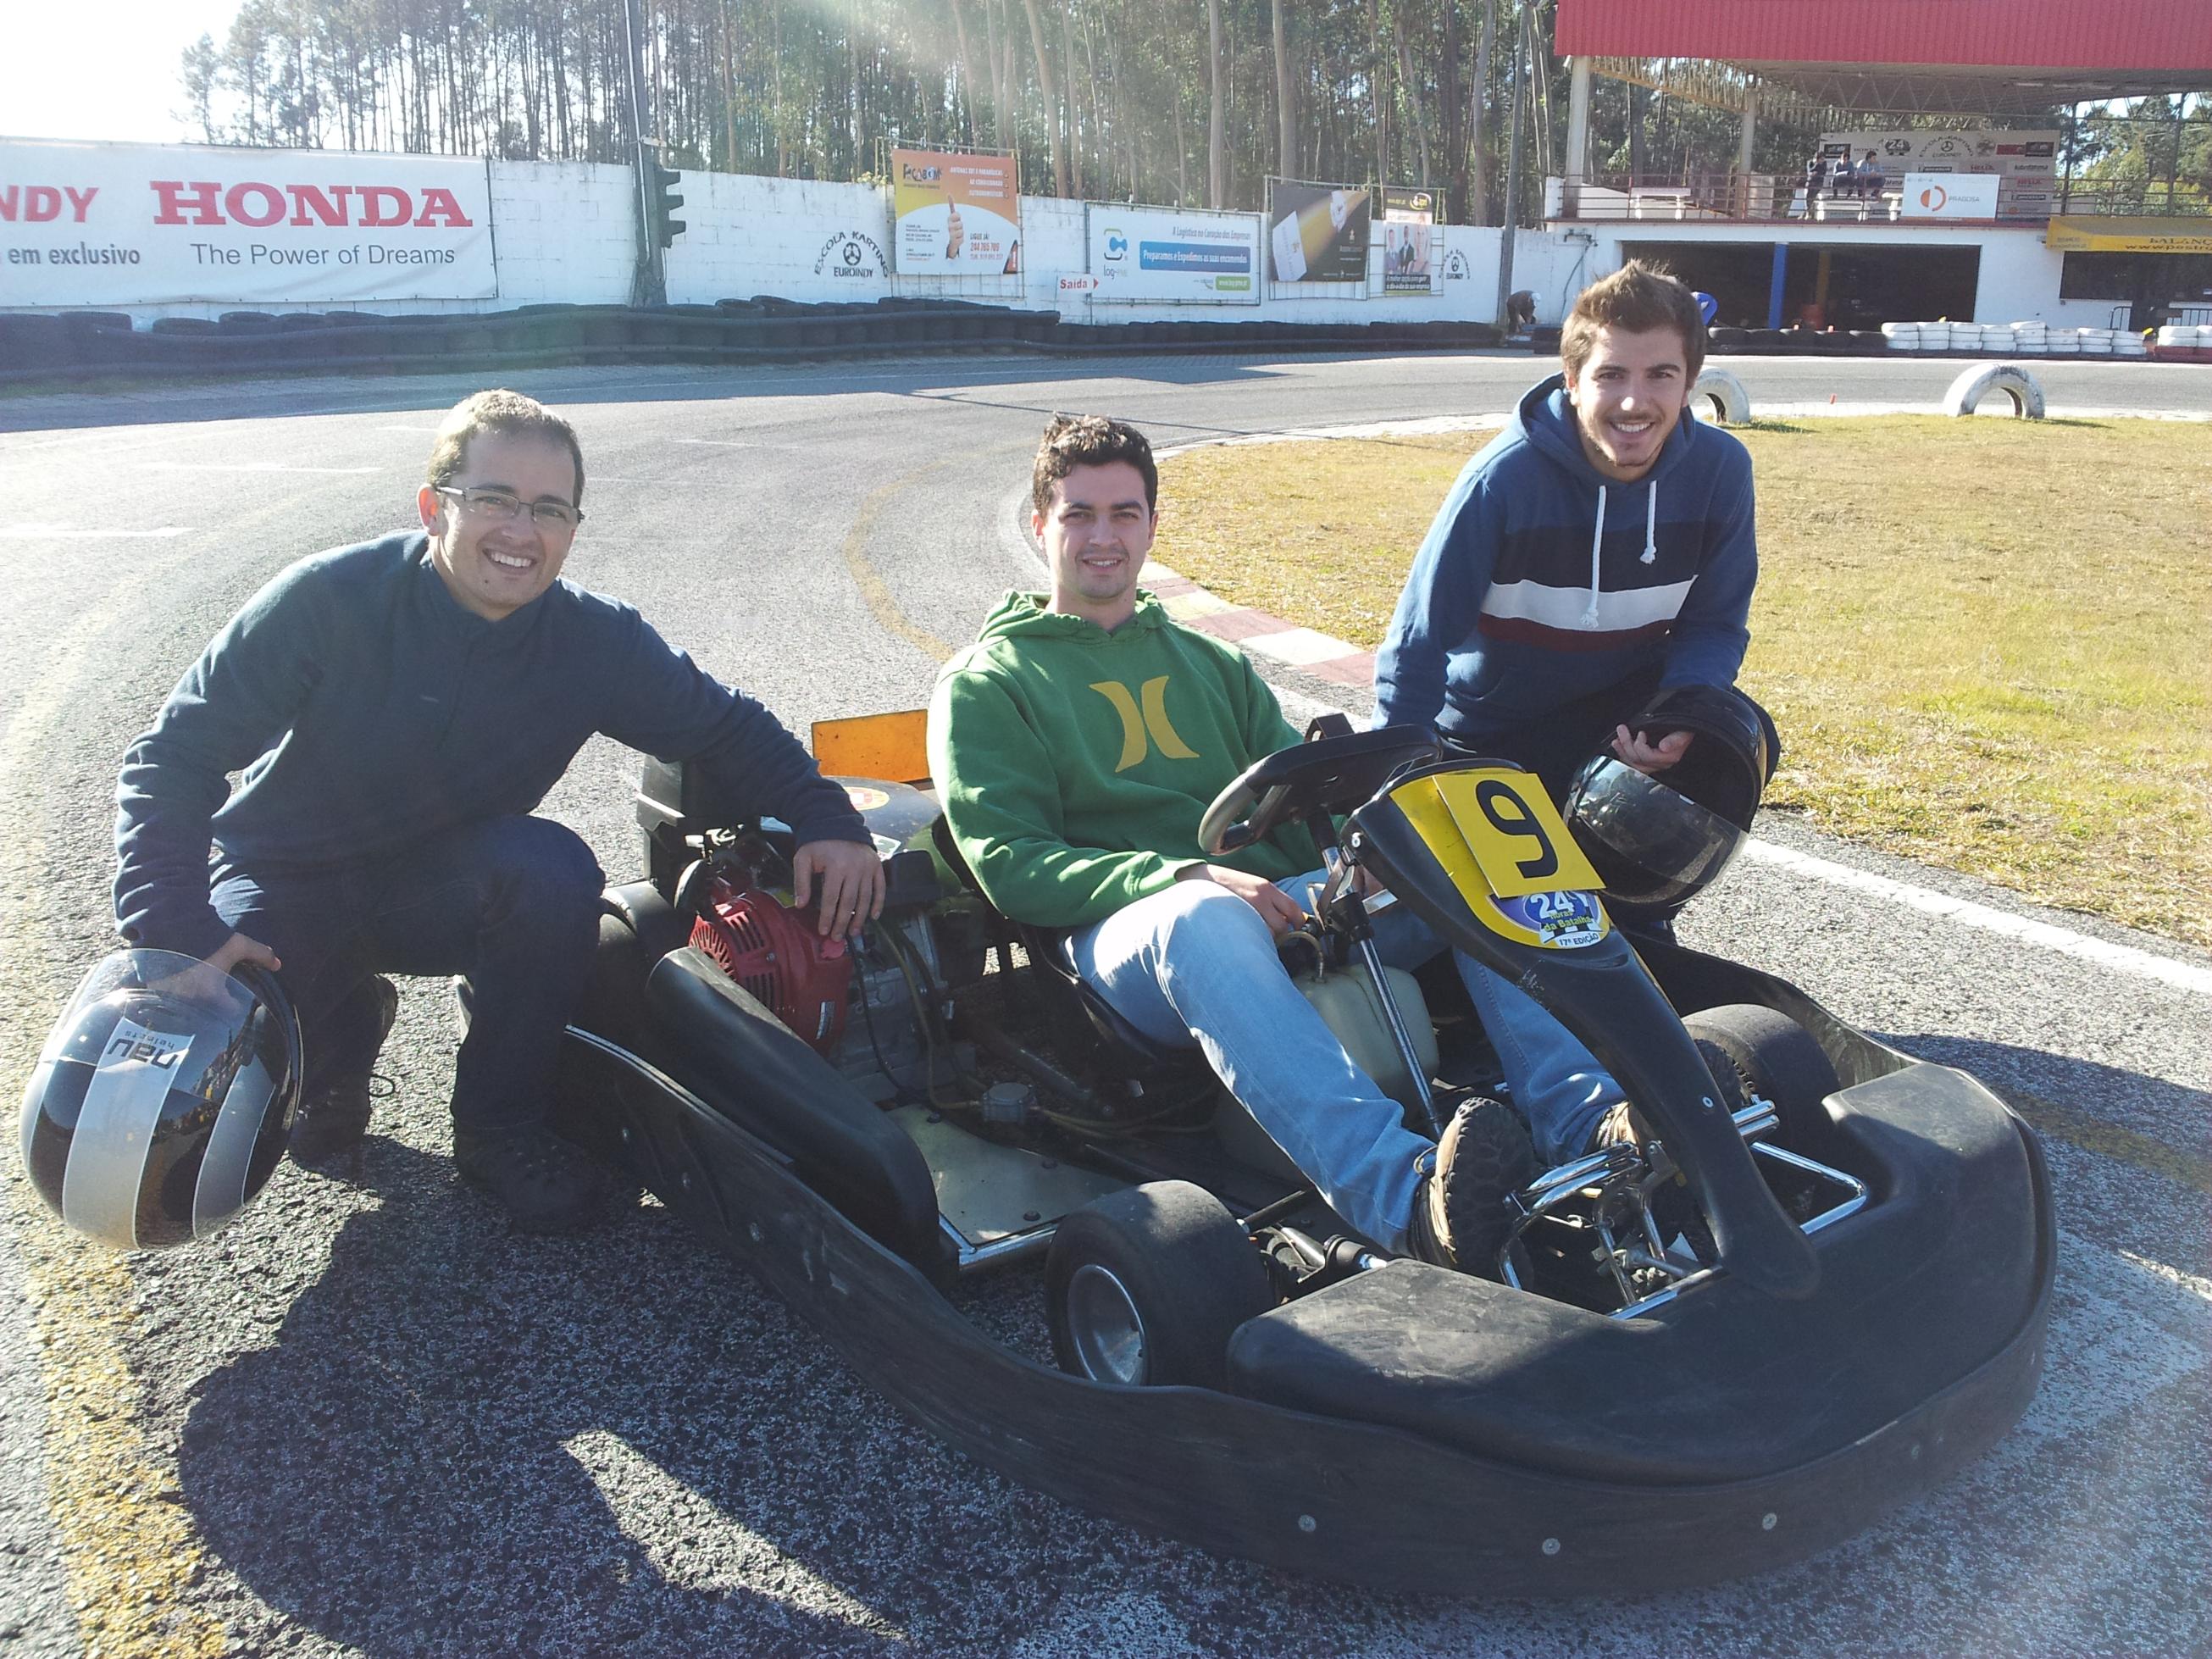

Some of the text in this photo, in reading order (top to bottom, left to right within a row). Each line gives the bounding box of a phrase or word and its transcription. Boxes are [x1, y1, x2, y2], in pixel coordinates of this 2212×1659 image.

[149, 180, 474, 227] HONDA
[8, 241, 141, 264] em exclusivo
[191, 243, 456, 265] The Power of Dreams
[813, 230, 846, 276] ESCOLA
[834, 266, 873, 278] EUROINDY
[1475, 780, 1559, 879] 9
[1529, 891, 1575, 919] 24
[1544, 916, 1592, 932] da Batalha
[1573, 932, 1599, 946] EDIÇÃO
